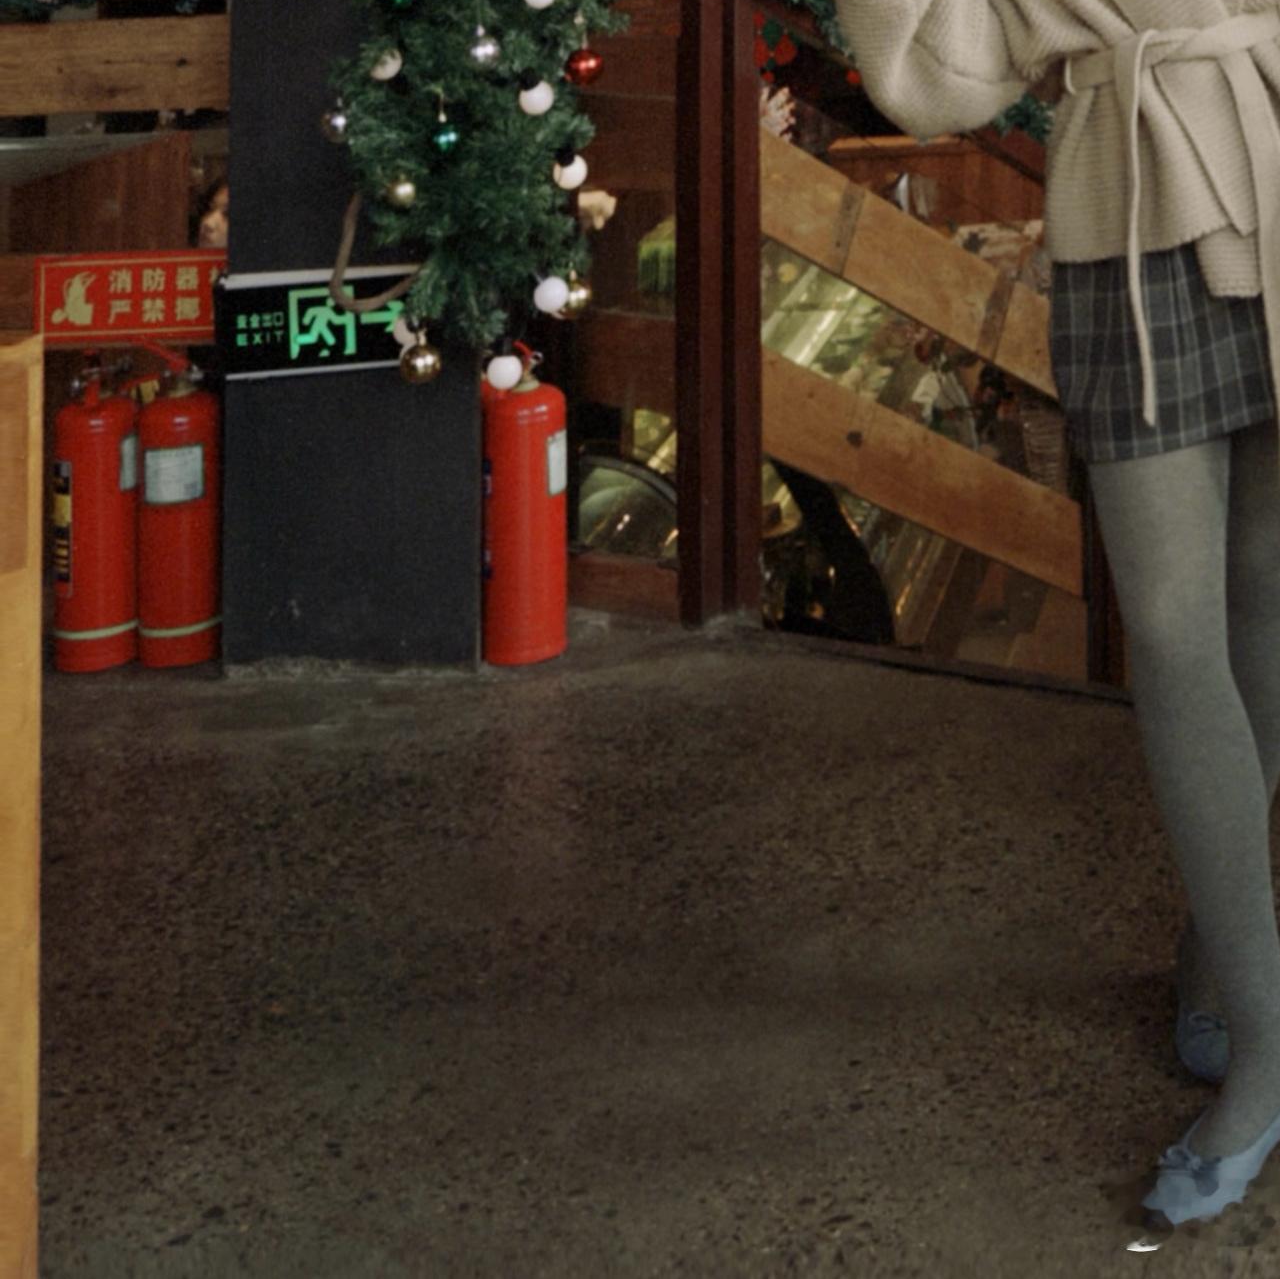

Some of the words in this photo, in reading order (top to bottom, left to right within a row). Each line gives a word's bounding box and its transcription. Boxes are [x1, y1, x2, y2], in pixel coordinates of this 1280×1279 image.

[108, 297, 214, 324] 严禁挪
[236, 330, 284, 346] EXIT
